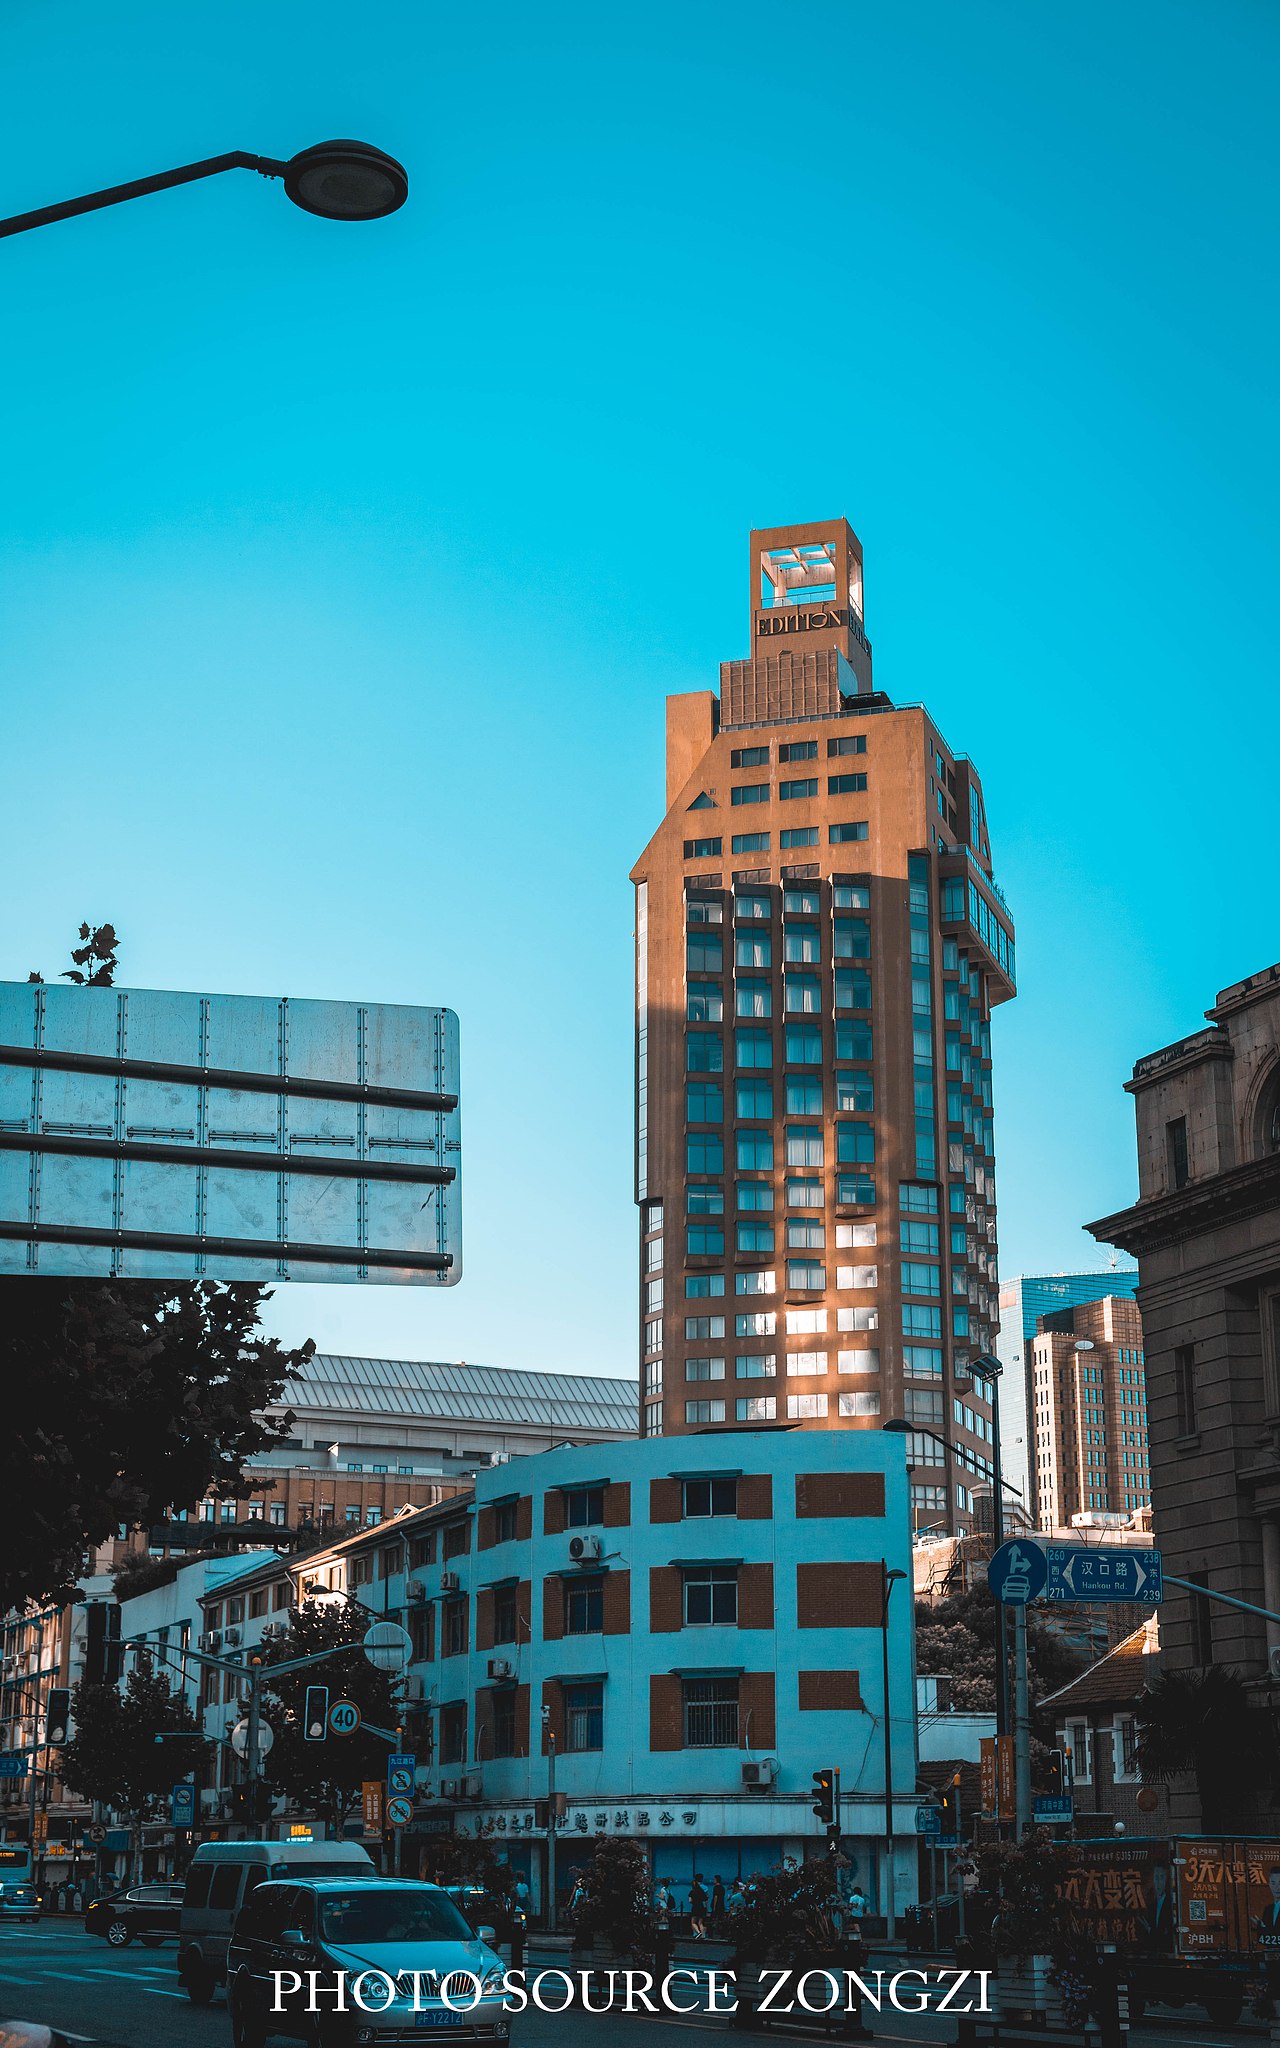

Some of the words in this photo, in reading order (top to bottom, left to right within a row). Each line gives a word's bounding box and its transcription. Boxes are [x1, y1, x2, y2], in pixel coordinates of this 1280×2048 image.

[756, 610, 841, 636] EDITION
[1049, 1550, 1065, 1561] 260
[1143, 1553, 1159, 1564] 238
[1051, 1566, 1060, 1576] 西
[1081, 1561, 1128, 1576] 汉口路
[1082, 1581, 1111, 1590] Hankou
[1114, 1582, 1128, 1590] Rd.
[1049, 1588, 1065, 1599] 271
[1143, 1589, 1160, 1601] 239
[334, 1709, 354, 1727] 40
[1184, 1857, 1268, 1884] 3天大变家
[1052, 1868, 1148, 1910] 天大变家
[1188, 1933, 1214, 1945] 沪BH
